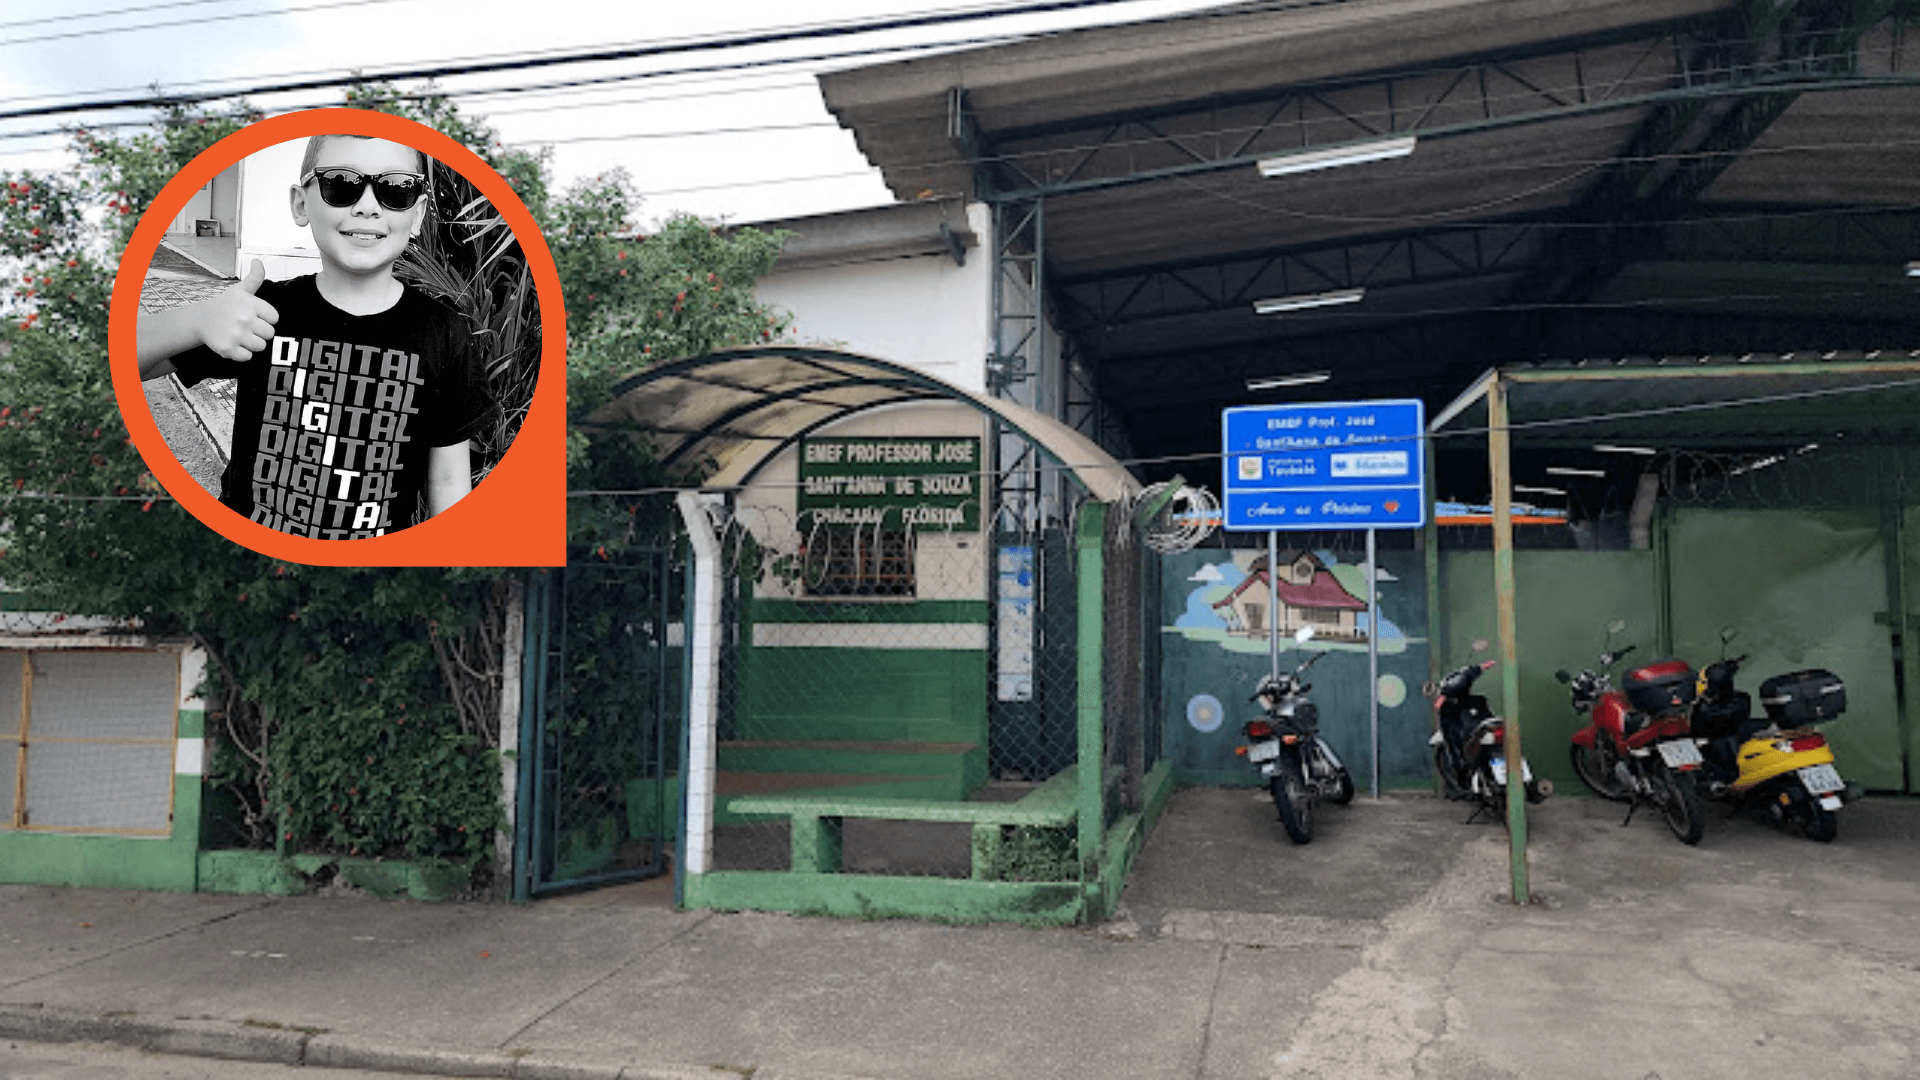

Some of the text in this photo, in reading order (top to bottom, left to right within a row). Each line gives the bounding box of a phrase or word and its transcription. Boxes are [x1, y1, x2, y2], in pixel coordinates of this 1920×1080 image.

[271, 336, 424, 385] DIGITAL
[267, 366, 419, 414] DIGITAL
[263, 395, 411, 442] DIGITAL
[258, 423, 403, 471] DIGITAL
[805, 440, 974, 463] EMEF PROFESSOR JOSÉ
[253, 452, 398, 501] DIGITAL
[895, 475, 915, 495] DE
[921, 474, 972, 495] SOUZA
[252, 481, 392, 529] DIGITAL
